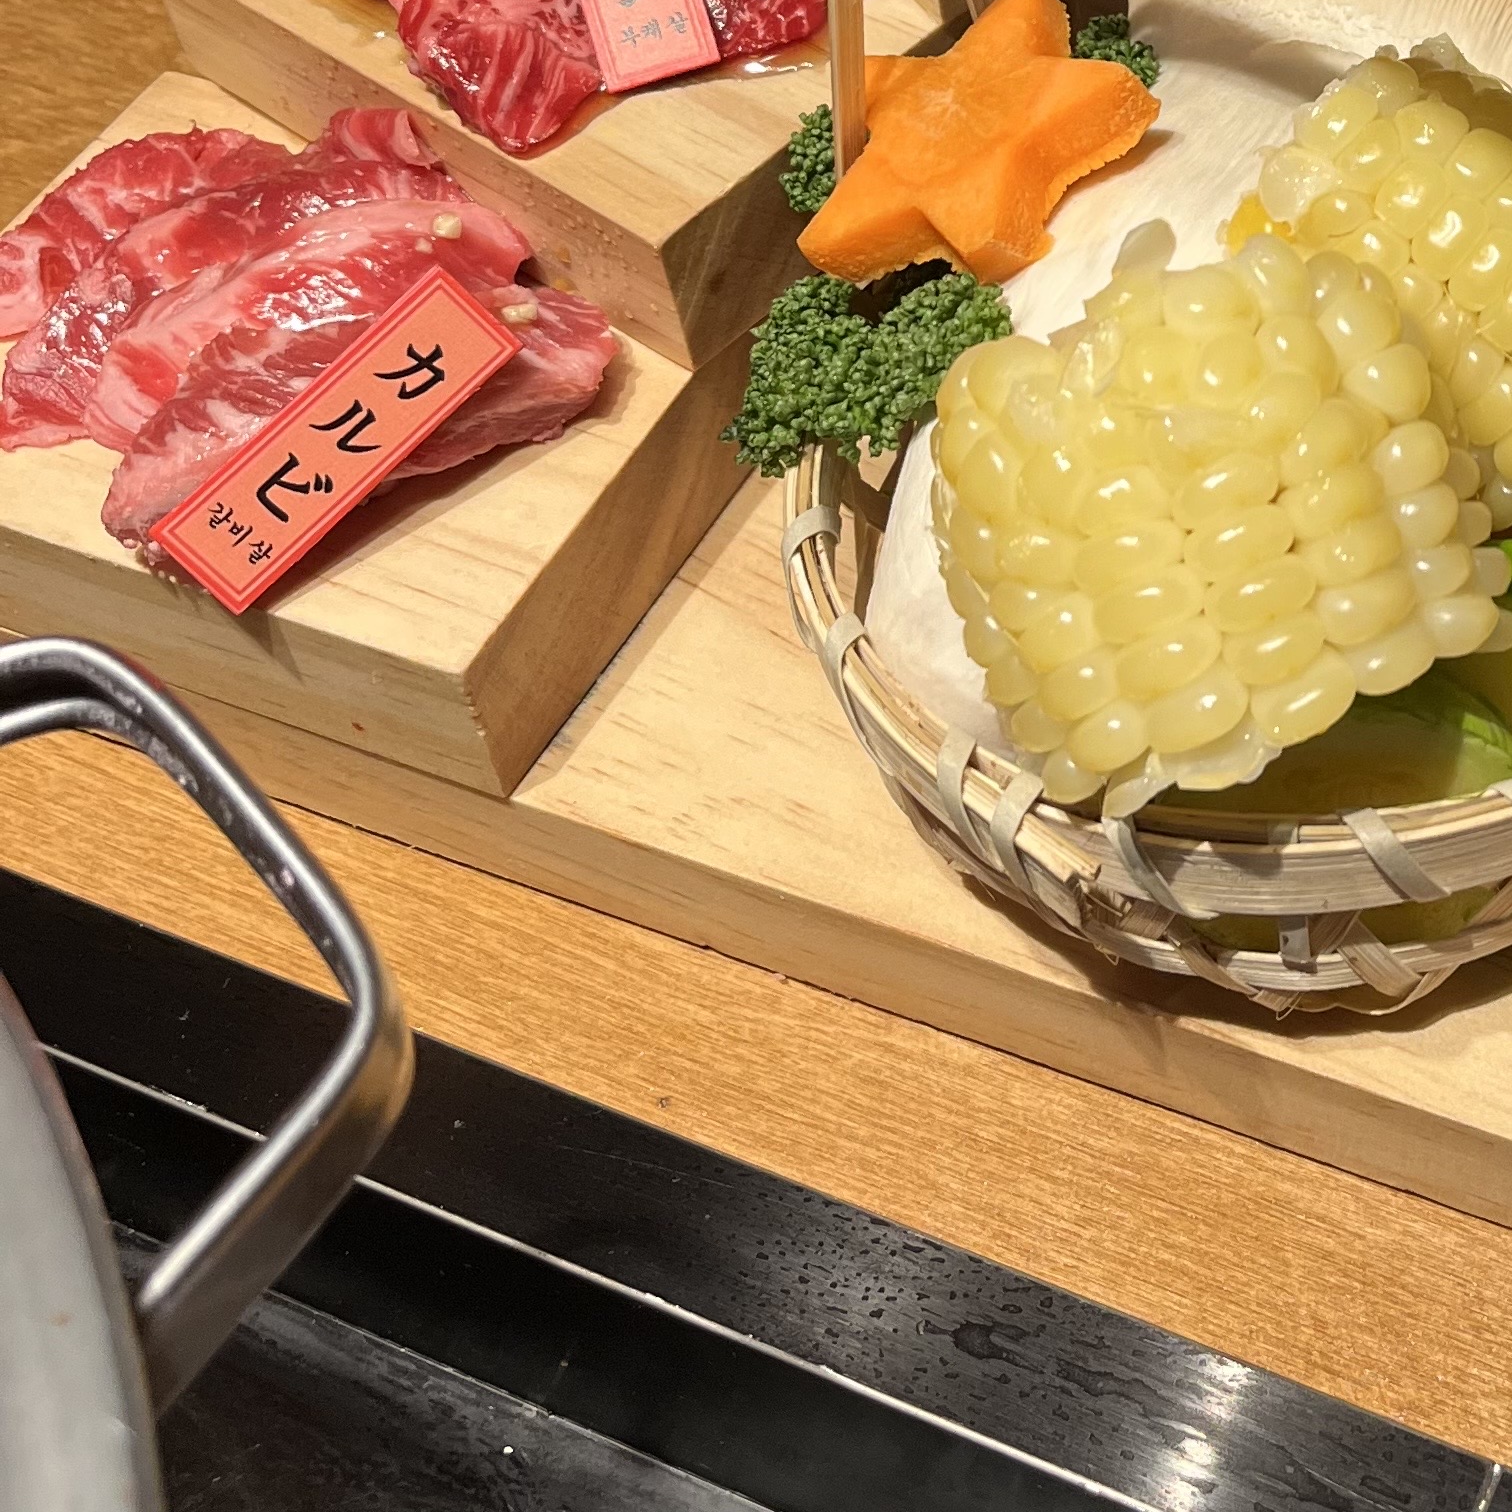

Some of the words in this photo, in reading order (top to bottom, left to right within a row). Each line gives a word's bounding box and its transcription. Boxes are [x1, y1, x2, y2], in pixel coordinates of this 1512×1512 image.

[256, 342, 445, 524] カルビ
[208, 501, 275, 565] 갈비살
